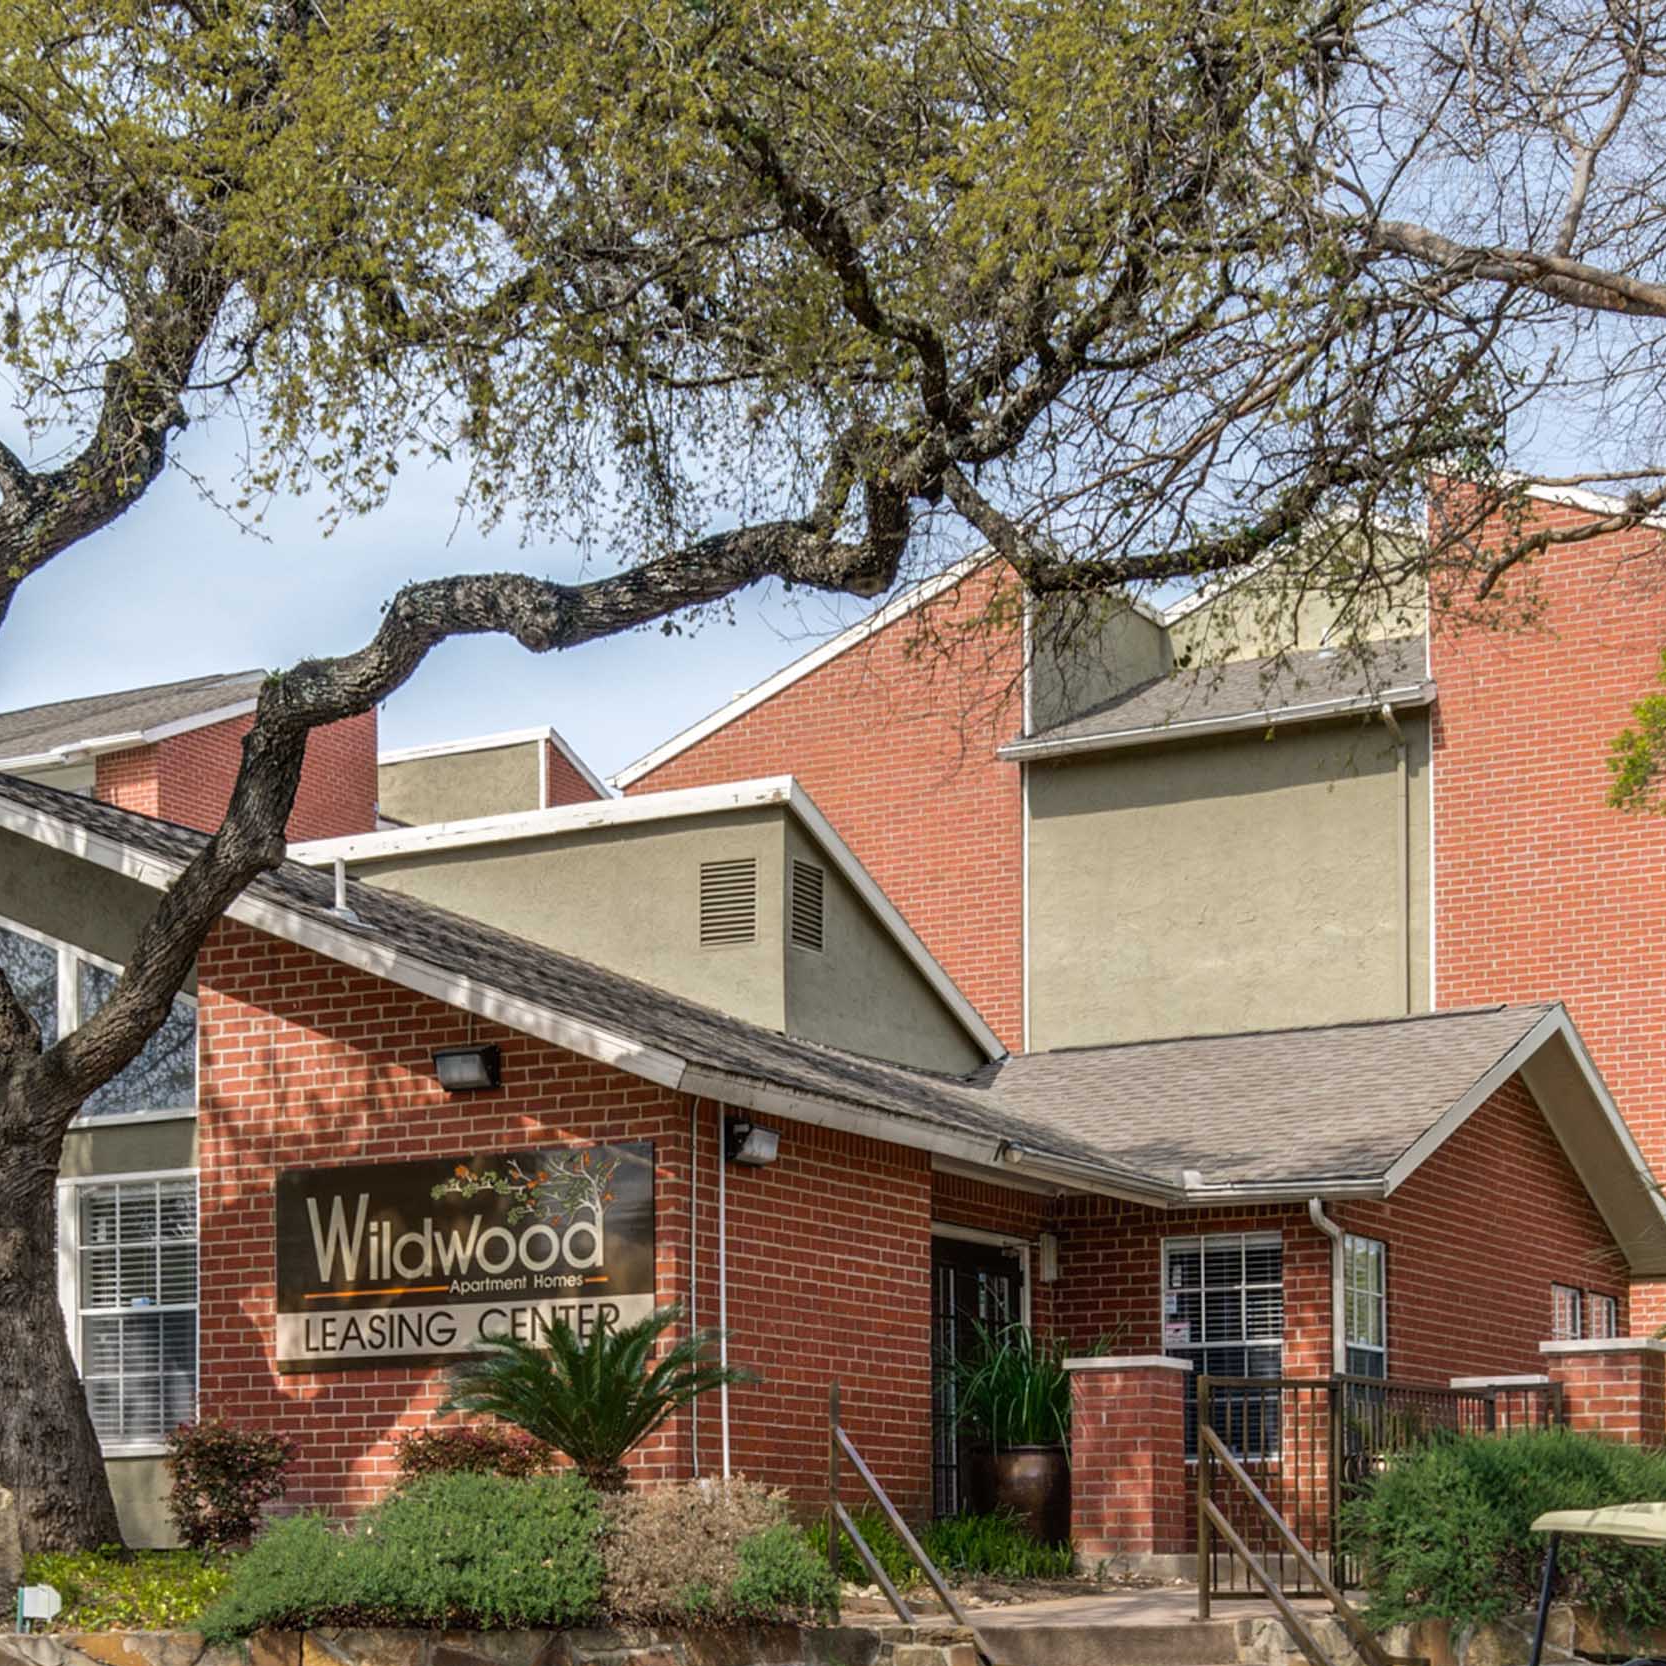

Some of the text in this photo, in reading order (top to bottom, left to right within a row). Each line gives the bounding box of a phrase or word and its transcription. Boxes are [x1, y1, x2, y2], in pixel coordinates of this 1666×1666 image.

[306, 1192, 605, 1283] Wildwood
[449, 1273, 584, 1295] Apartment Homes
[304, 1303, 620, 1353] LEASING CENTER
